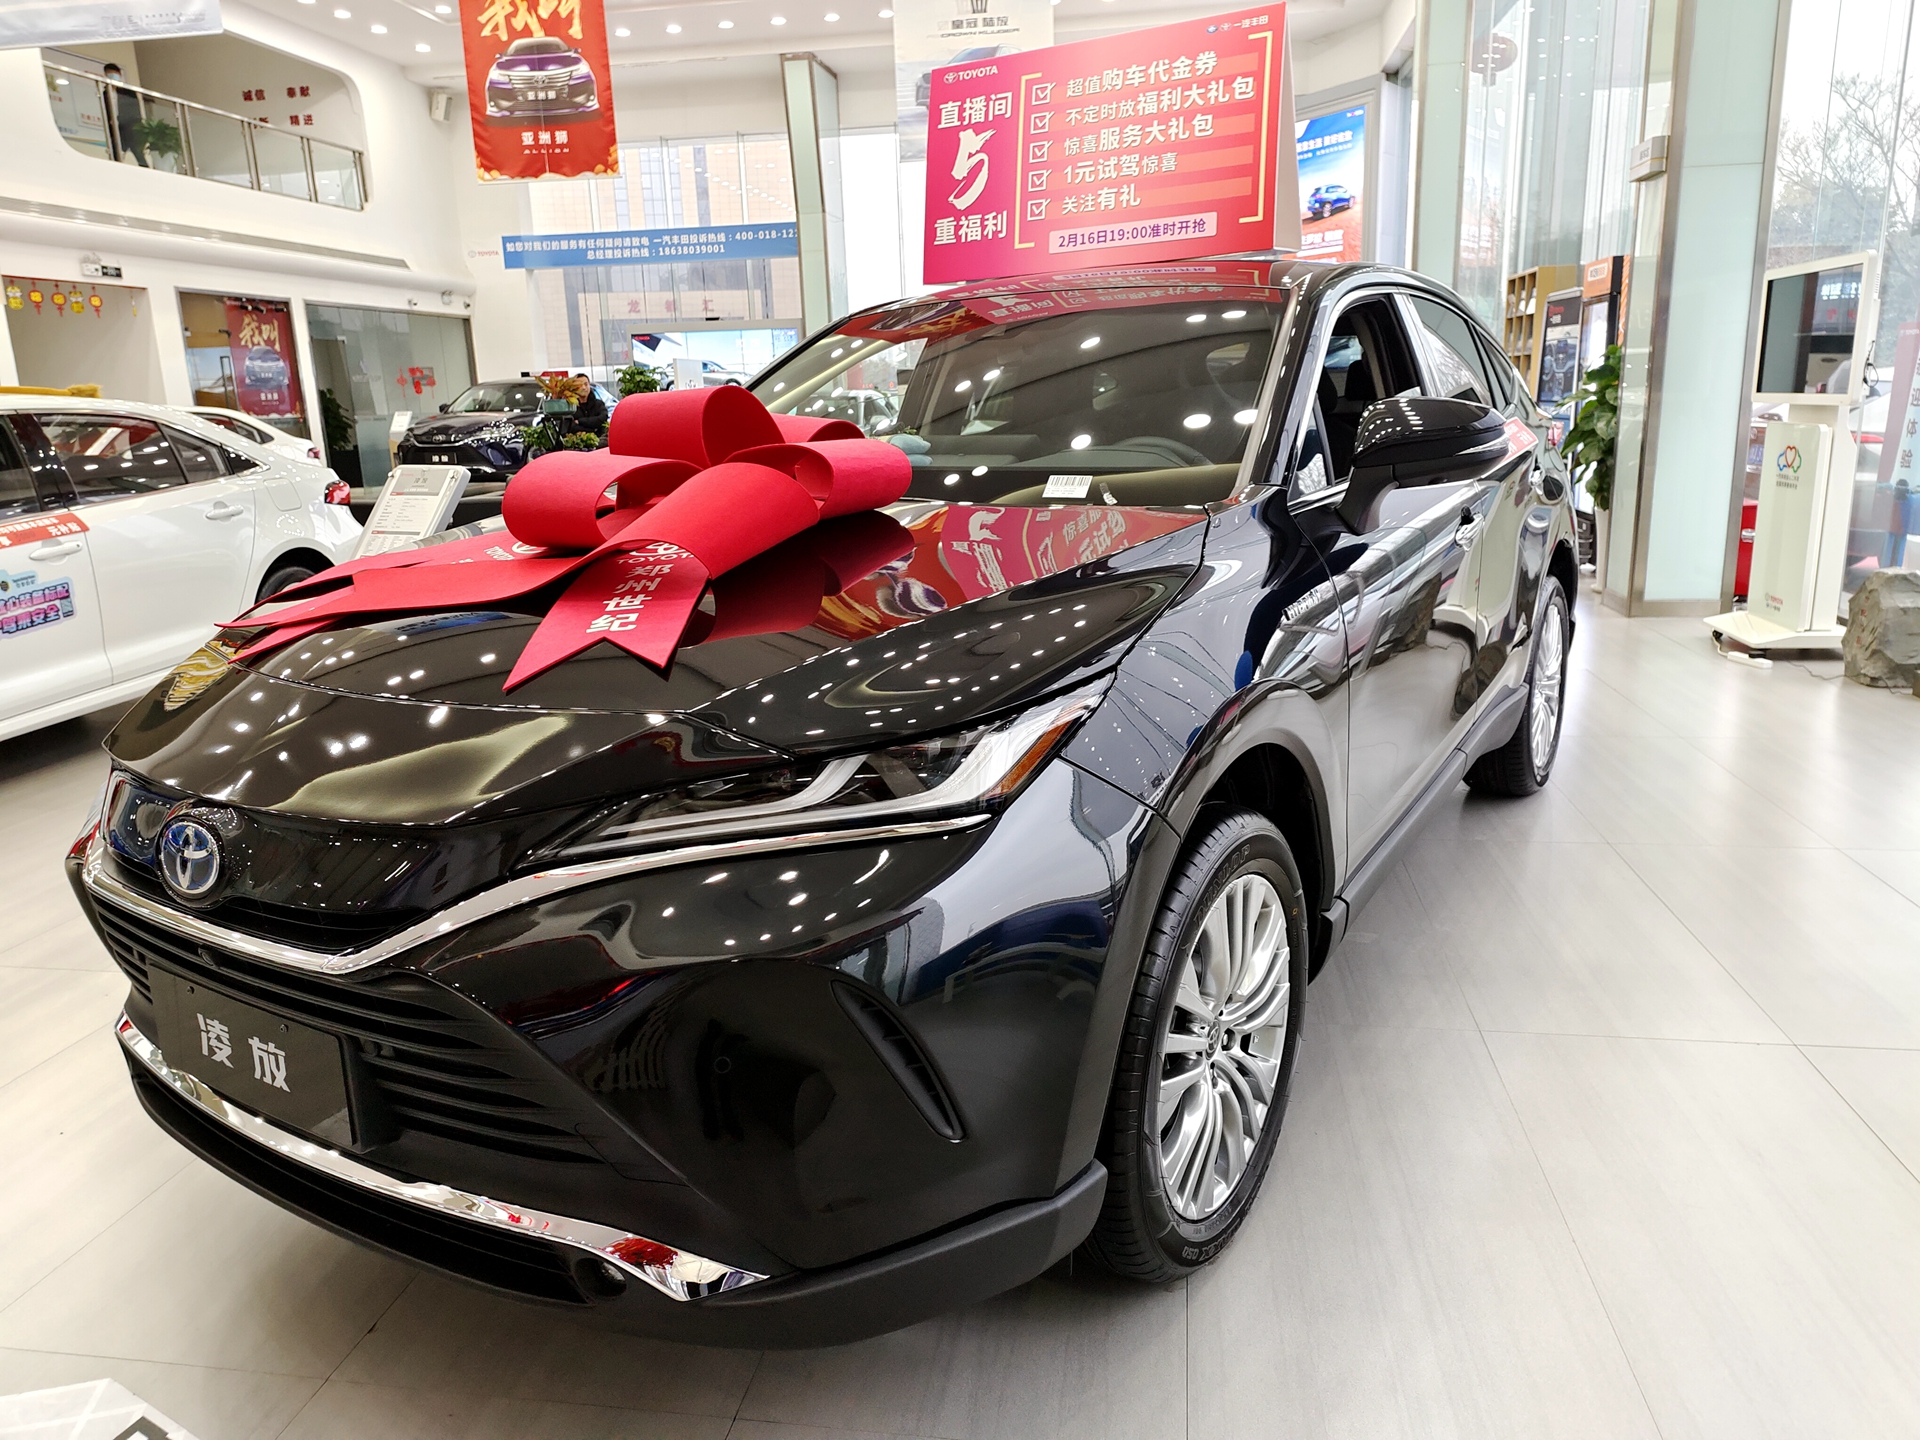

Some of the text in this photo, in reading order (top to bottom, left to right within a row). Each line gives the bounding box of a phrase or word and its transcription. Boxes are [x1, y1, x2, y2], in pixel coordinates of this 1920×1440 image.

[952, 16, 1009, 30] 皇冠 陆放
[1233, 15, 1268, 29] 一汽丰田
[957, 65, 999, 81] TOYOTA
[1066, 51, 1218, 98] 超值购车代金券
[937, 92, 1013, 129] 直播间
[1065, 76, 1255, 127] 不定时放福利大礼包
[521, 130, 569, 146] 亚洲狮
[1064, 113, 1214, 156] 惊喜服务大礼包
[948, 129, 998, 211] 5
[1063, 152, 1178, 185] 1元试驾惊喜
[1062, 183, 1142, 215] 关注有礼
[934, 210, 1008, 246] 重福利
[1058, 218, 1207, 248] 2月16日19:00准时开抢
[585, 563, 674, 633] 郑州世纪
[0, 604, 60, 634] 驾乘安全
[197, 1013, 291, 1093] 凌放
